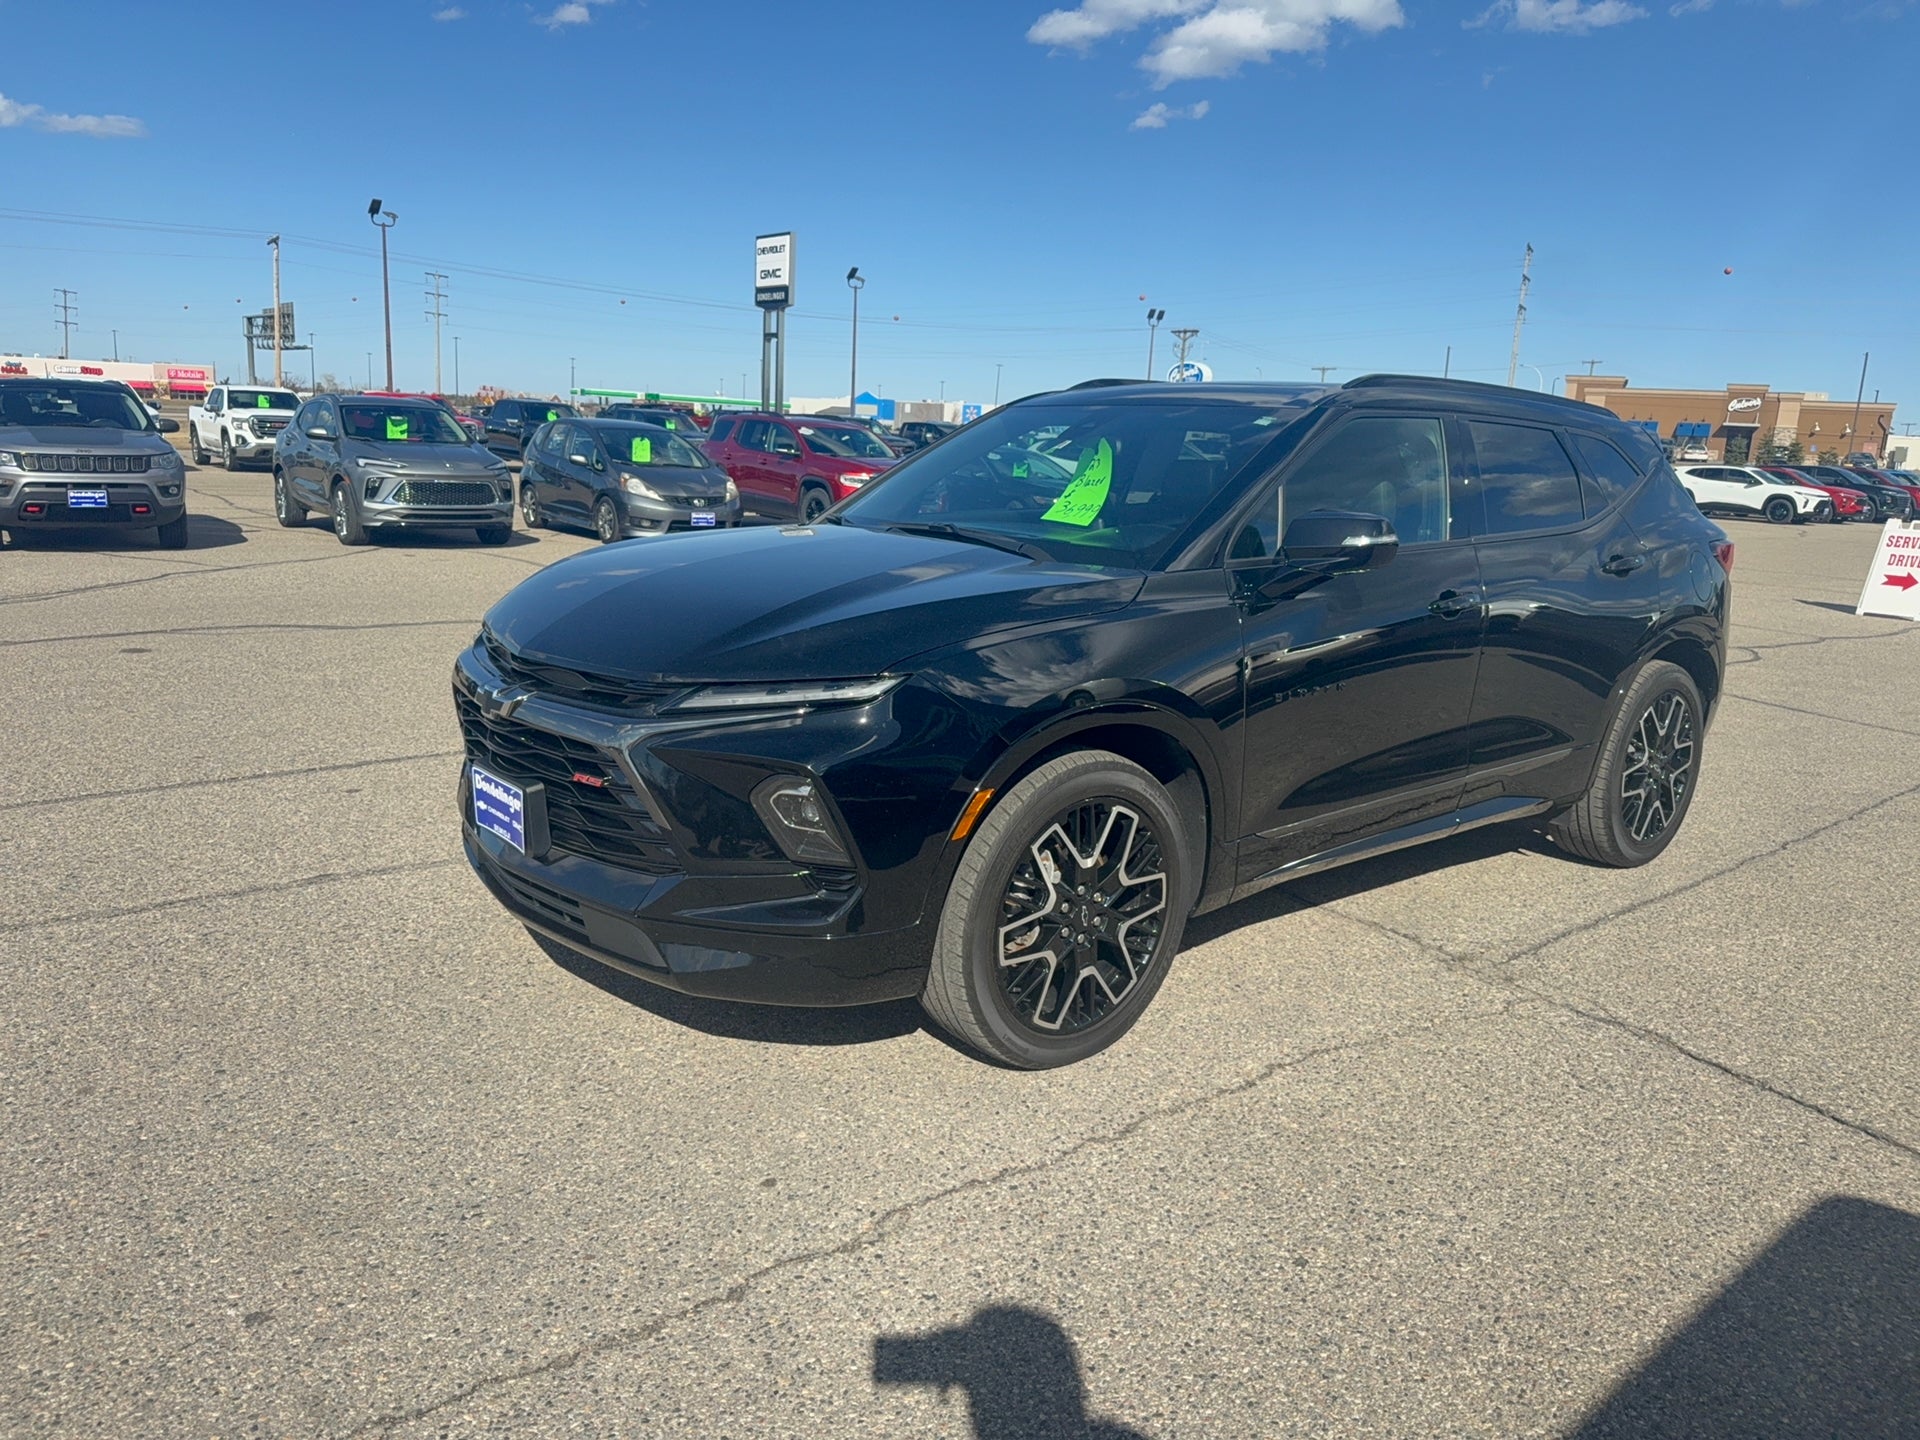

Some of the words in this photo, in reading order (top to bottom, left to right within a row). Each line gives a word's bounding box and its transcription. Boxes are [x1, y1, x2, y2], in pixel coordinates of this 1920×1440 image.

[757, 244, 786, 256] CHEVROLET
[760, 268, 782, 280] GMC
[55, 364, 104, 376] GameStop
[1886, 535, 1920, 549] SERV
